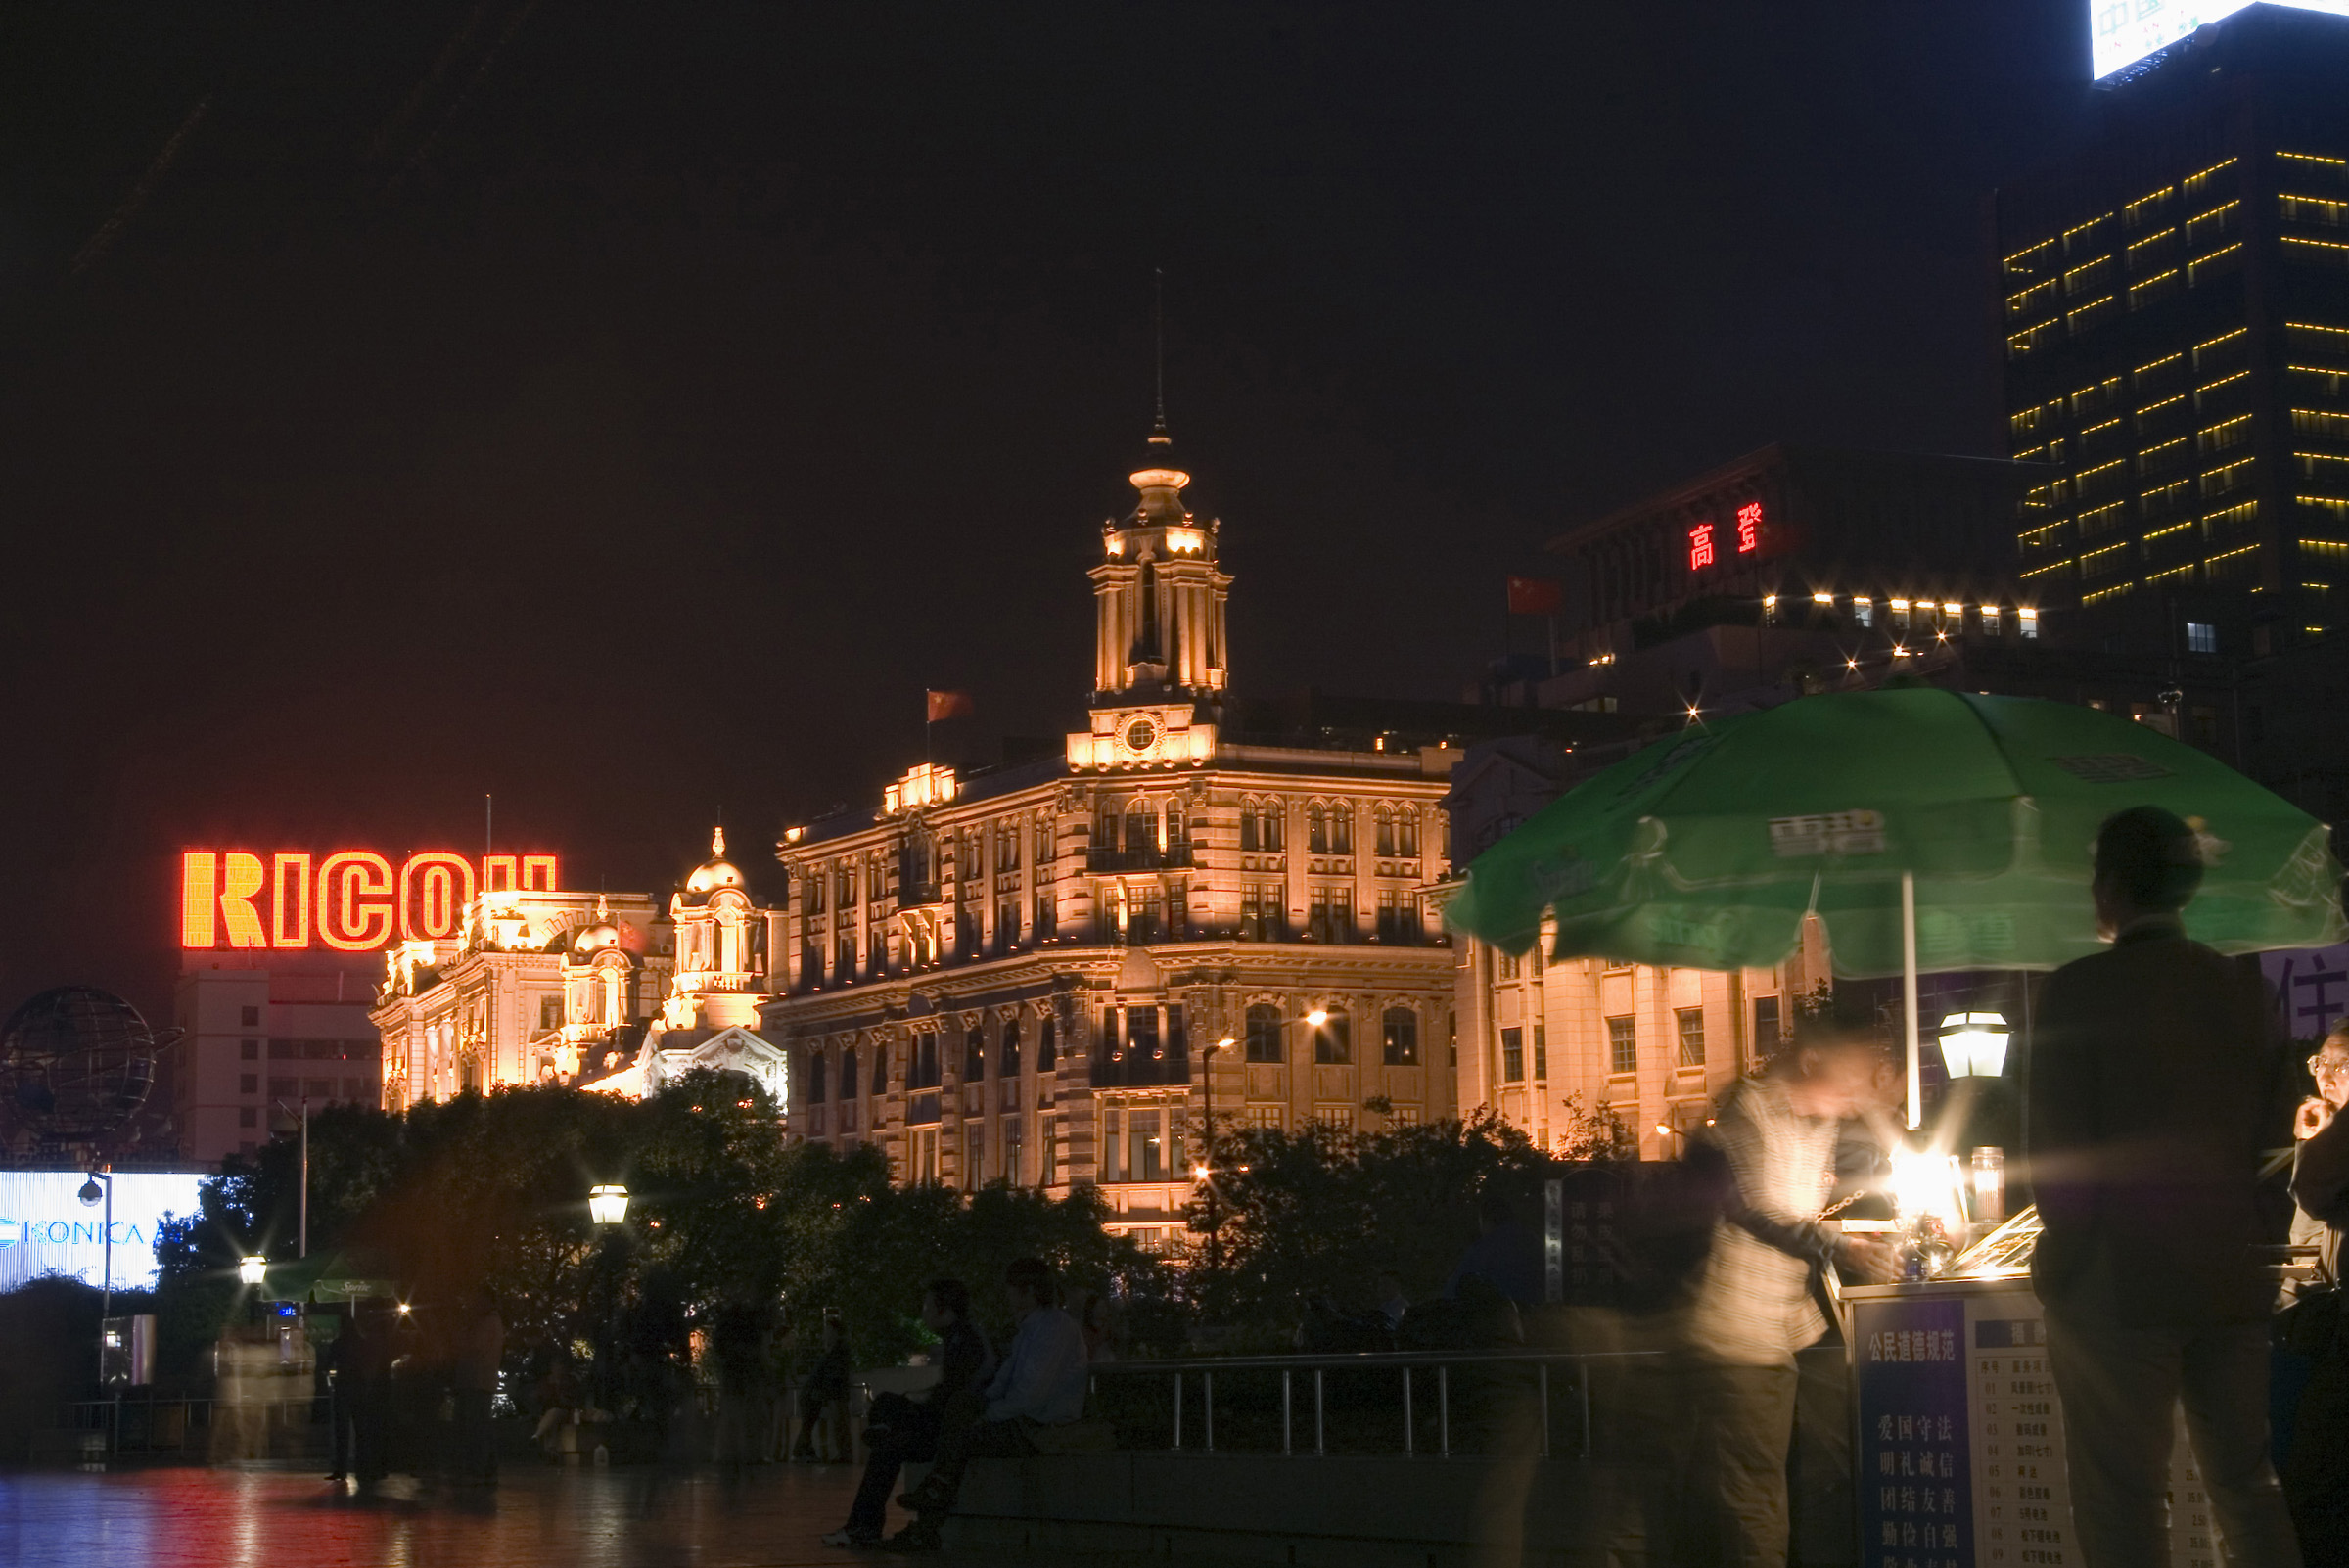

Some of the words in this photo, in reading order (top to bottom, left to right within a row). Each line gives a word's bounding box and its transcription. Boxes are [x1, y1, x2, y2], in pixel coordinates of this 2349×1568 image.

[24, 1221, 144, 1245] KONICA
[341, 1281, 372, 1294] Sprite
[1868, 1329, 1956, 1362] 公民道德规范
[1985, 1382, 1996, 1395] 01
[1986, 1402, 1997, 1415] 02
[1877, 1414, 1953, 1443] 爱国守法
[1987, 1423, 1998, 1436] 03
[1987, 1444, 1999, 1456] 04
[1879, 1451, 1955, 1478] 明礼诚信
[1989, 1464, 2000, 1478] 05
[1989, 1486, 2001, 1499] 06
[1880, 1486, 1956, 1514] 团结友善
[1990, 1506, 2002, 1519] 07
[1882, 1520, 1958, 1548] 勤俭自强
[1991, 1527, 2003, 1540] 08
[1992, 1547, 2004, 1561] 09
